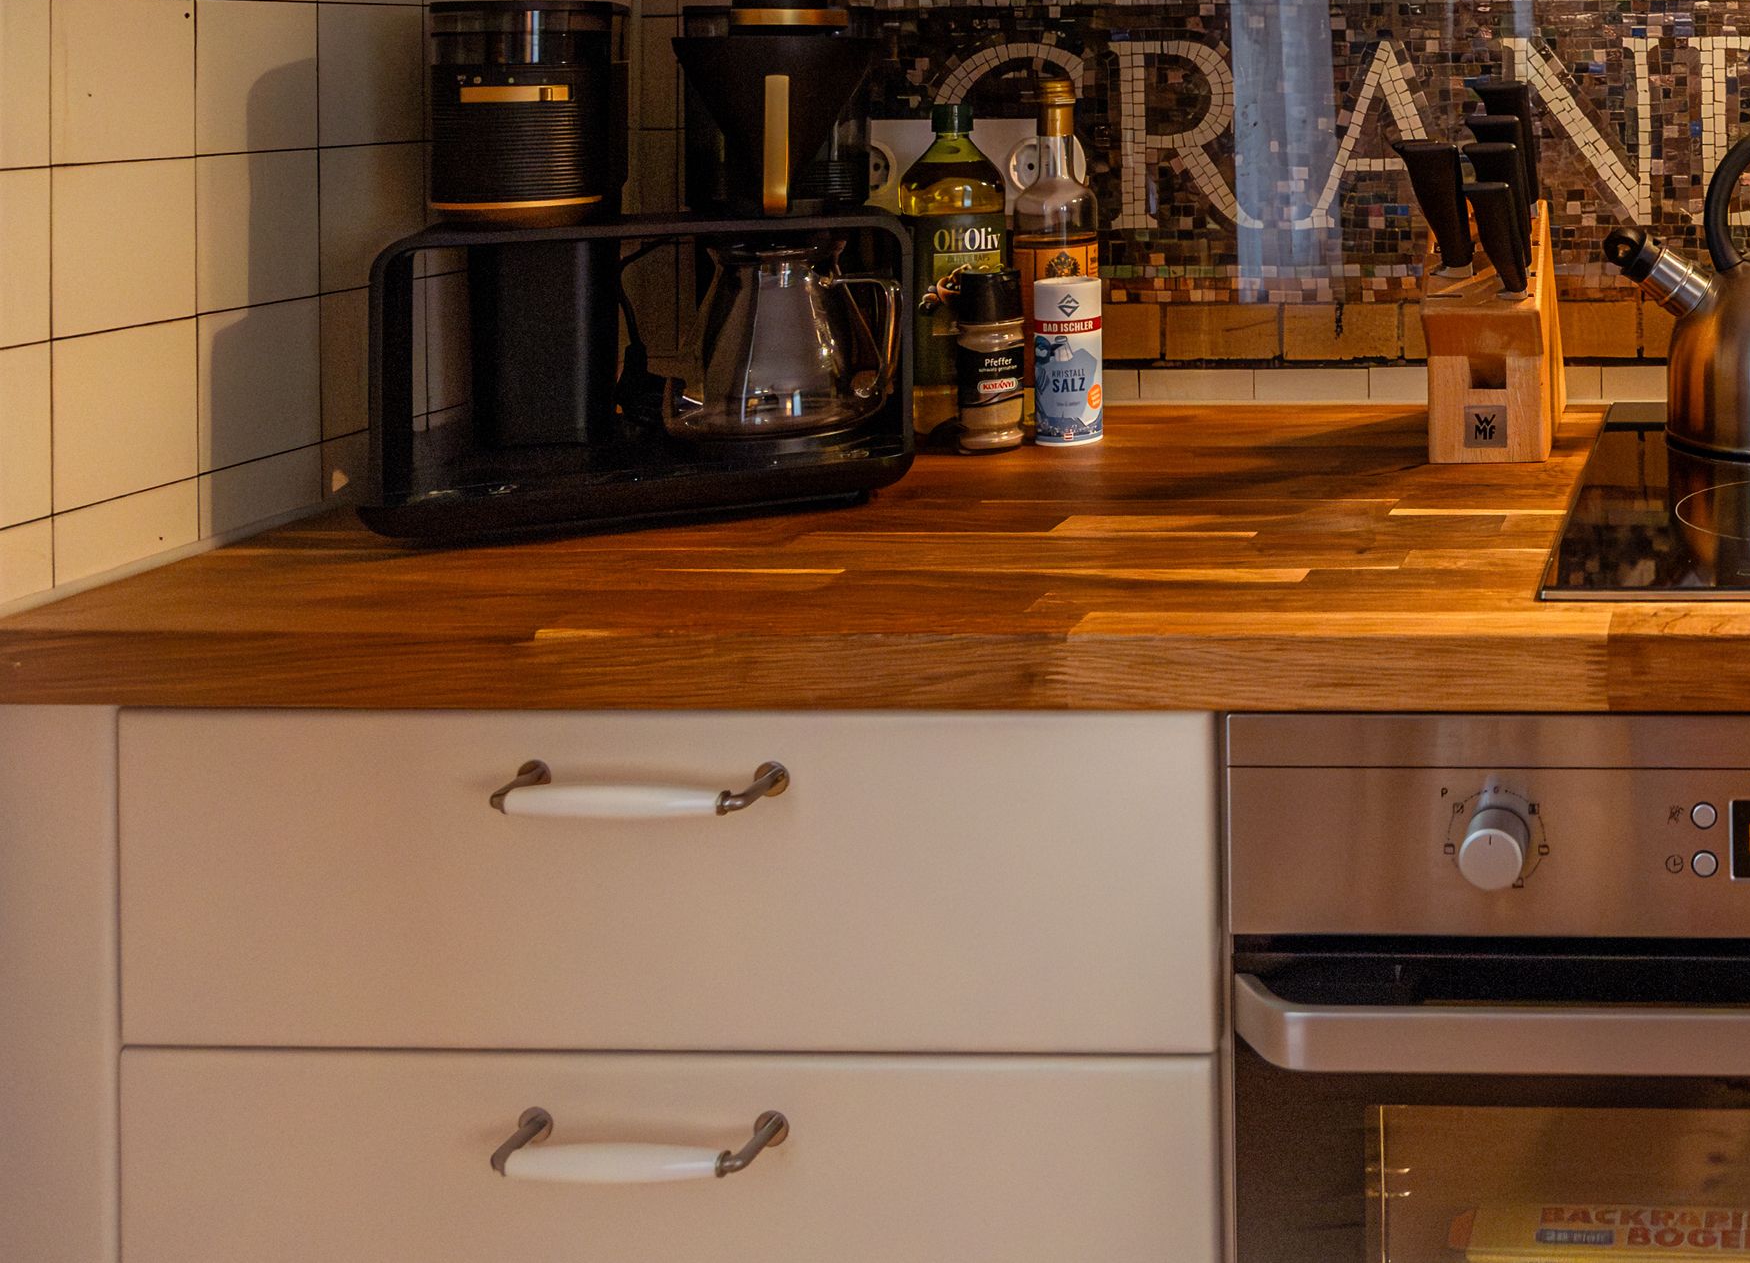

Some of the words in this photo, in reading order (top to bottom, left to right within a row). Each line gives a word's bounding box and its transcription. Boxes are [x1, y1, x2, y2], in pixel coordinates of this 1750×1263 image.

[1043, 322, 1058, 332] BAD
[1060, 320, 1094, 332] ISCHLER
[984, 357, 1013, 367] Pfeffer
[1052, 369, 1086, 378] KRISTALL
[1052, 377, 1086, 393] SALZ
[1474, 413, 1497, 440] WMF
